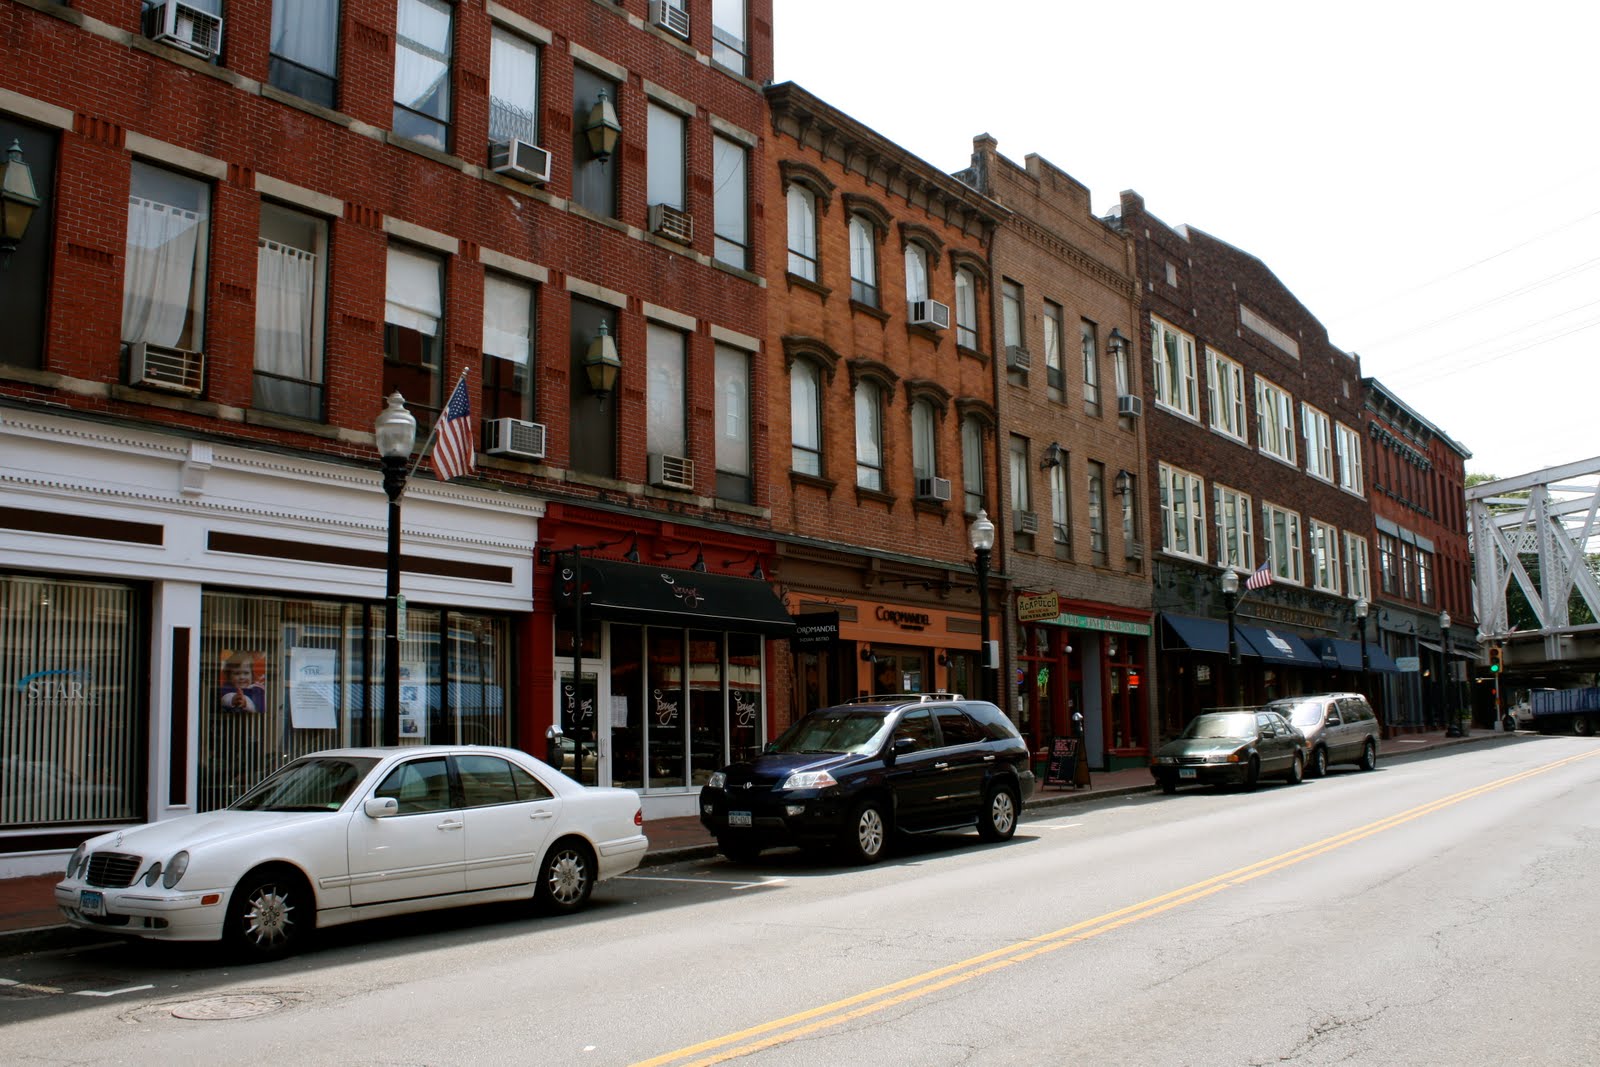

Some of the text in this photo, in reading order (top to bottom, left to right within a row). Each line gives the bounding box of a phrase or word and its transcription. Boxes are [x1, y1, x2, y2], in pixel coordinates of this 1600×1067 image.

[1019, 597, 1057, 611] ACAPULCO
[876, 606, 931, 625] COROMANDEL
[1020, 611, 1058, 620] RESTAURANT
[796, 624, 838, 635] OROMANDEL
[304, 668, 320, 676] STAR
[28, 681, 84, 699] STAR
